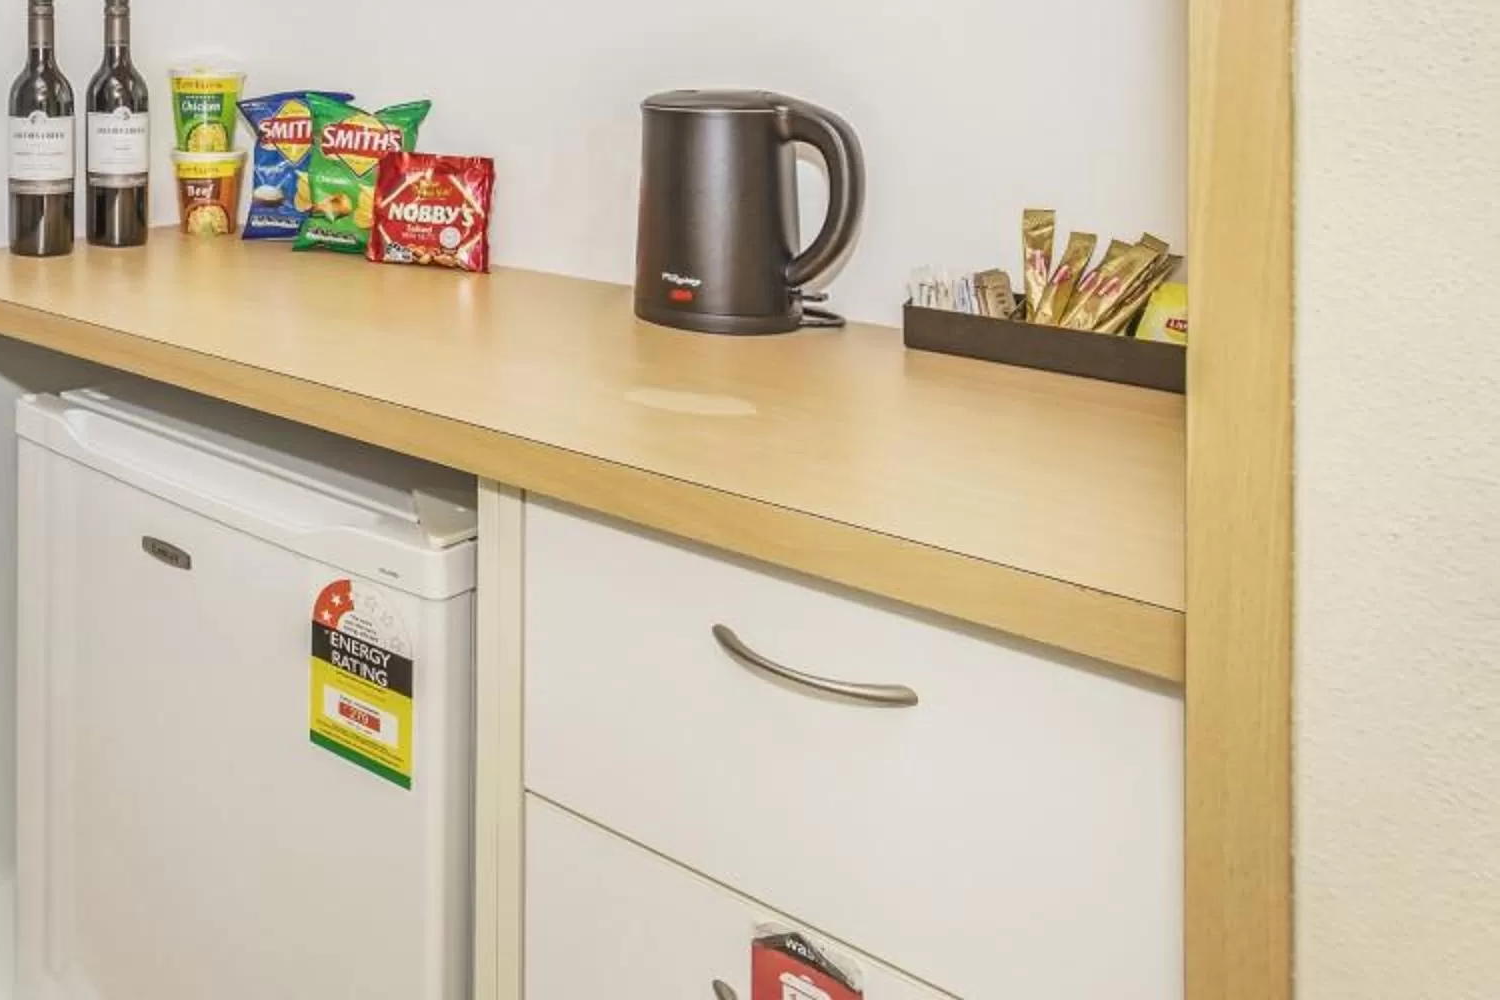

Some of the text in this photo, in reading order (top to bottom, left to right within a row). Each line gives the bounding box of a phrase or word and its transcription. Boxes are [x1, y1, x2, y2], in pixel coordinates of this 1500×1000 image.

[181, 101, 222, 112] Chicken
[258, 119, 312, 140] SMIT
[186, 183, 215, 199] Beef
[330, 631, 391, 669] ENERGY
[331, 649, 389, 687] RATING
